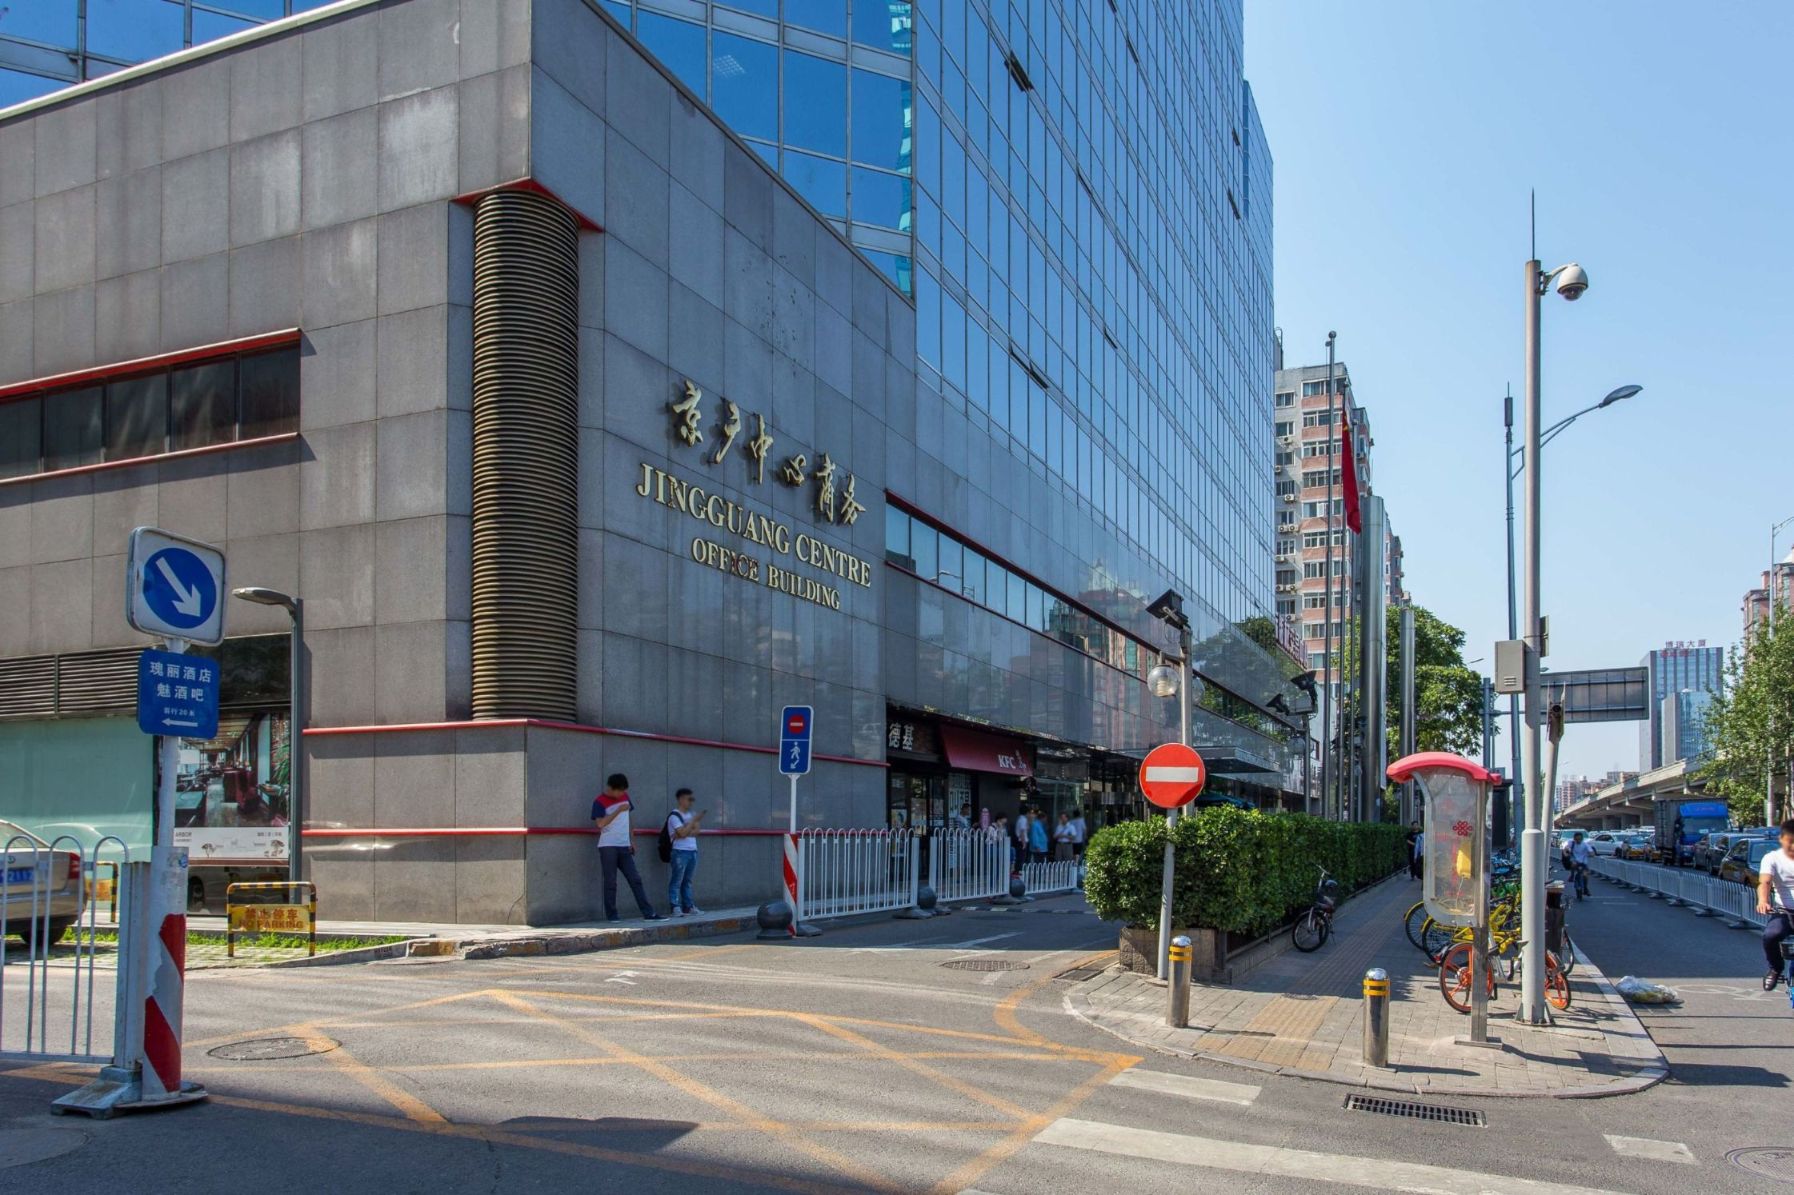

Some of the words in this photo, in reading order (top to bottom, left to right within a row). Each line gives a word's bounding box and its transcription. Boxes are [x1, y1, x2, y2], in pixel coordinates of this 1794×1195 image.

[636, 463, 789, 554] JINGGUANG
[795, 533, 872, 588] CENTRE
[692, 537, 760, 582] OFFICE
[767, 564, 840, 610] BUILDING
[150, 661, 212, 683] 瑰丽酒店
[157, 682, 204, 702] 魅酒吧
[998, 754, 1016, 769] KFC
[257, 919, 304, 929] PARKING
